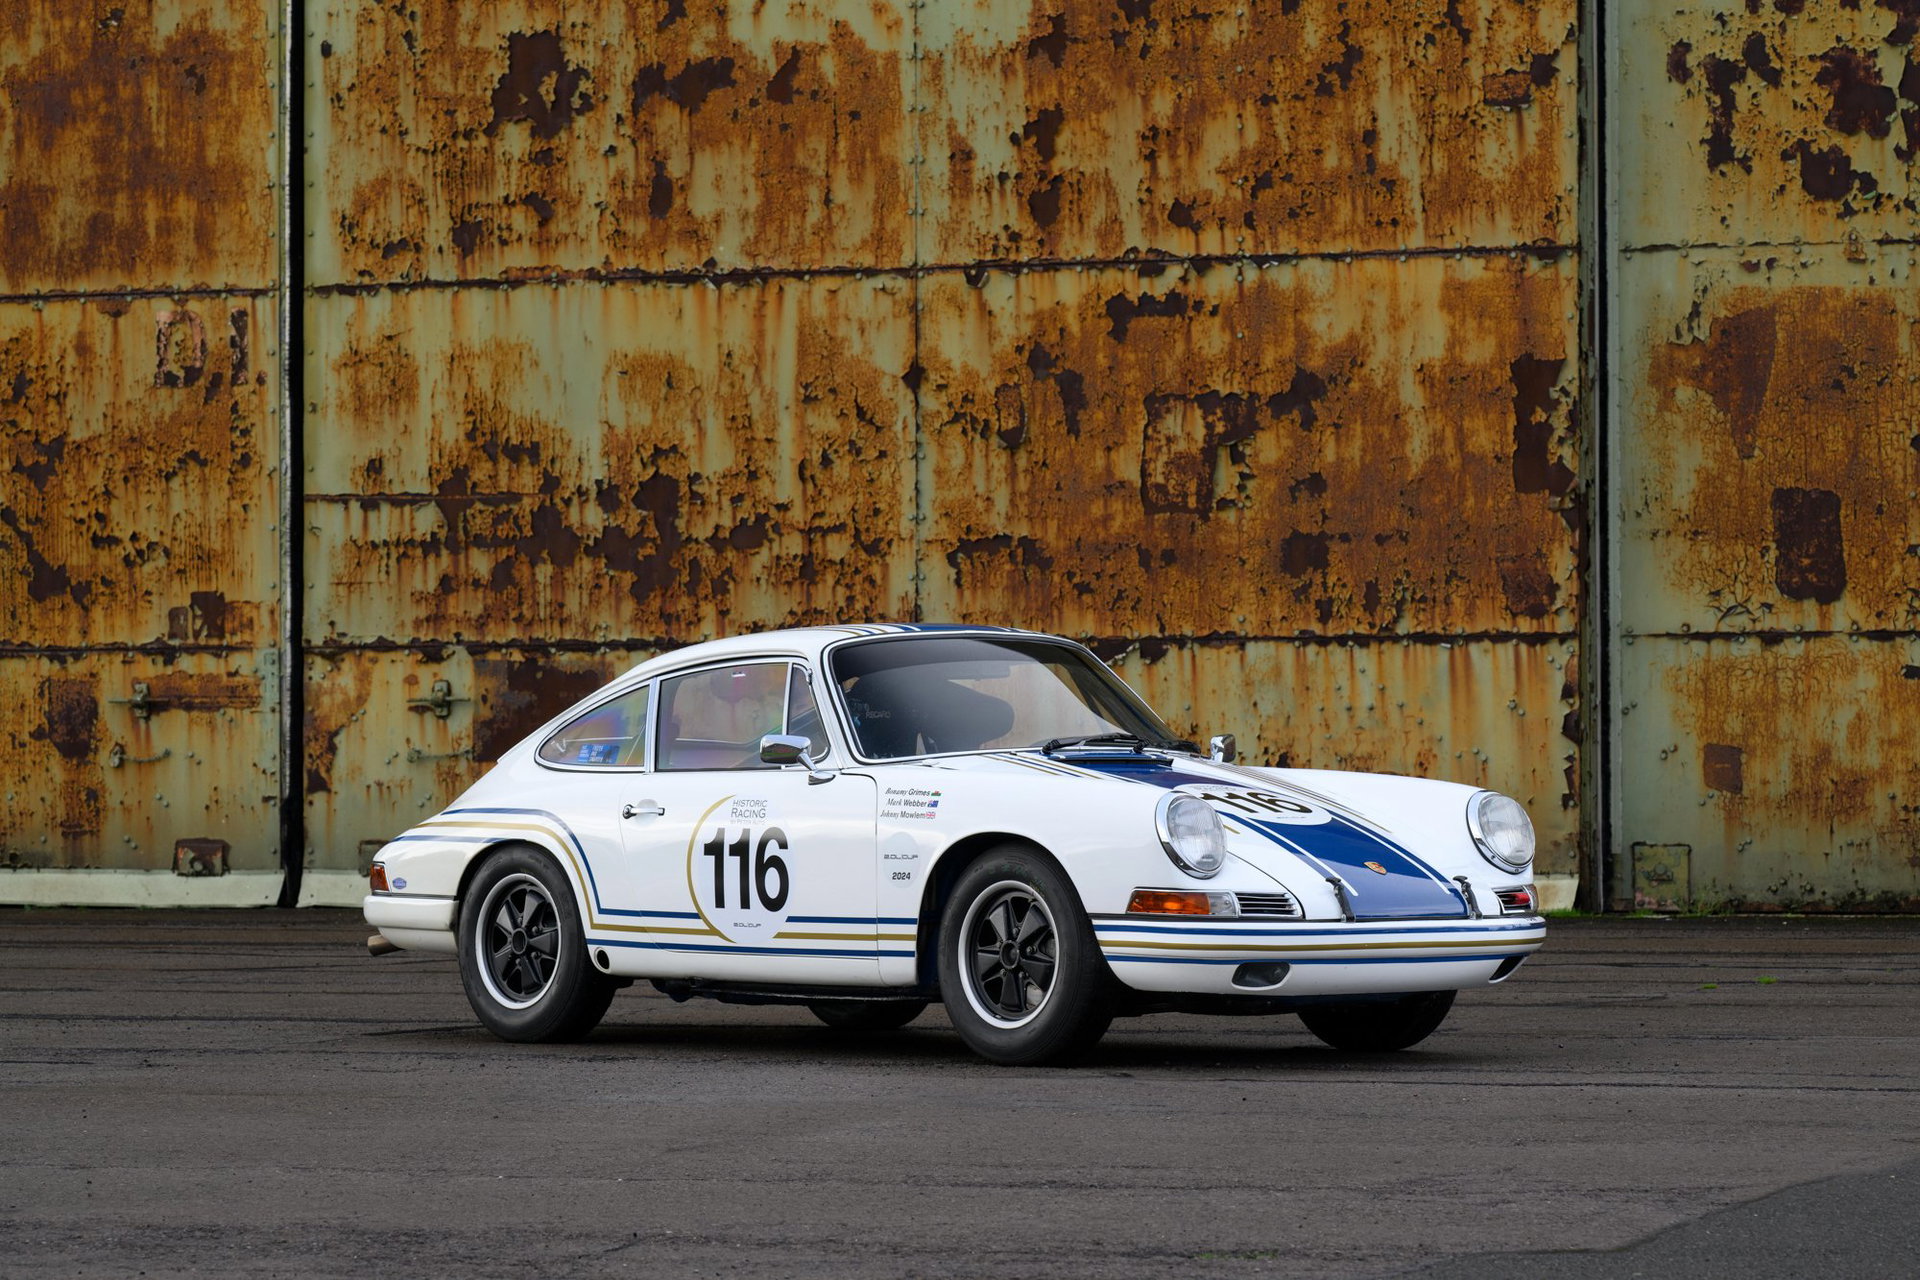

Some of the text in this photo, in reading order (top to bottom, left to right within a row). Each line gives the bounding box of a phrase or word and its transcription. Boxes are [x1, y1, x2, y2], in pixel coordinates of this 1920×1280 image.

[908, 788, 930, 796] Grimes
[732, 799, 768, 808] HISTORIC
[887, 798, 928, 807] Mark Webber
[730, 807, 766, 819] RACING
[900, 810, 926, 819] Mowlem
[703, 826, 789, 913] 116
[892, 871, 911, 880] 2024
